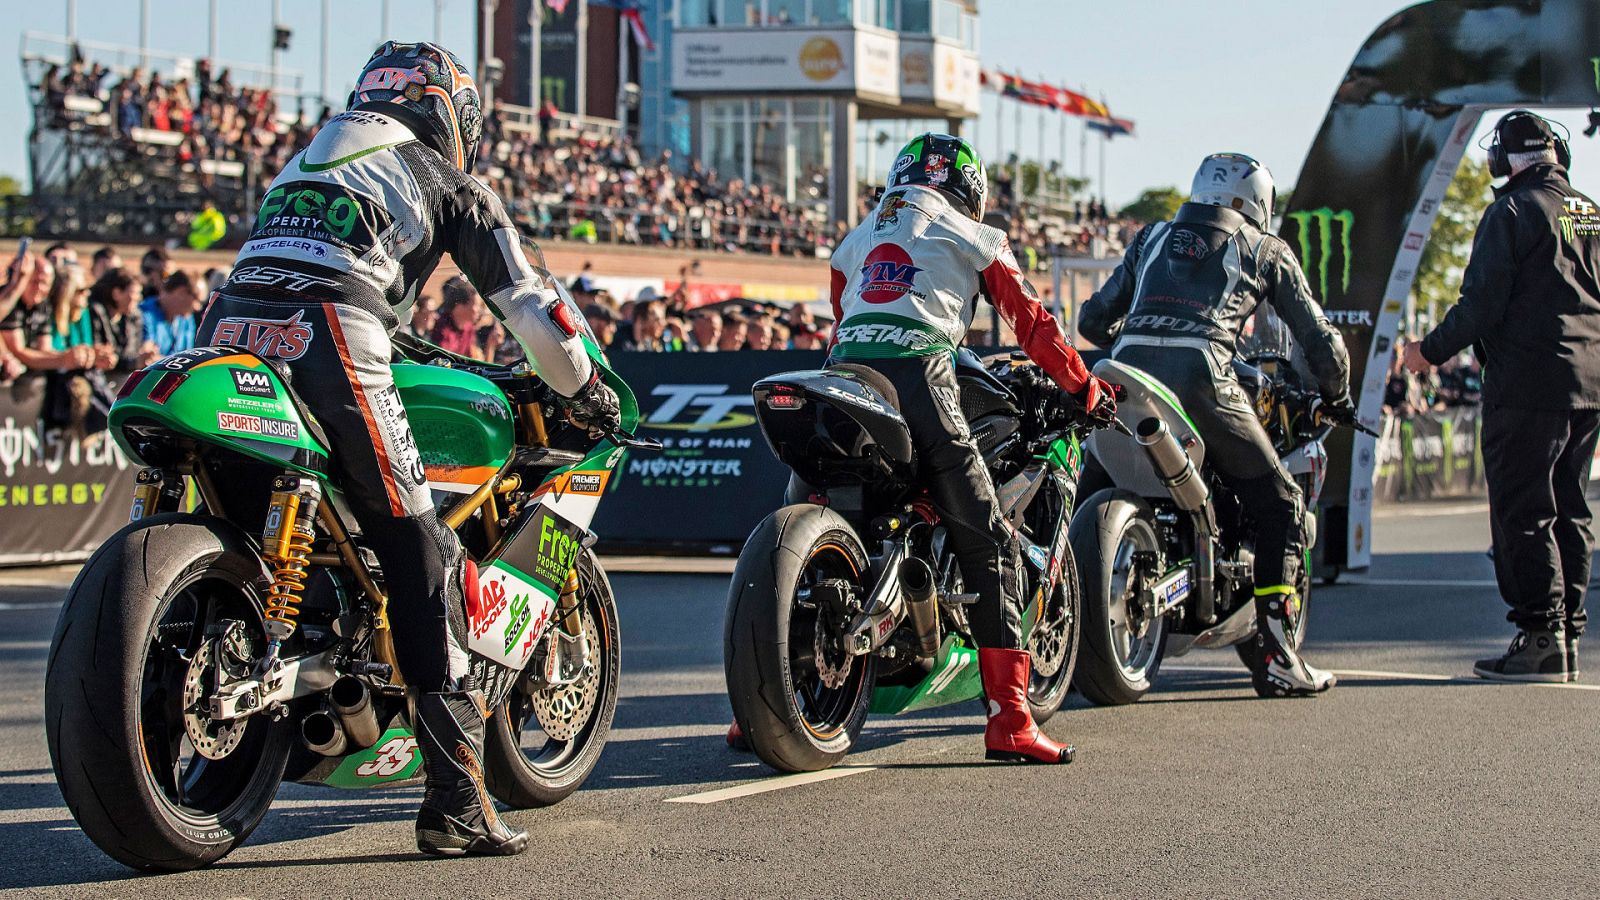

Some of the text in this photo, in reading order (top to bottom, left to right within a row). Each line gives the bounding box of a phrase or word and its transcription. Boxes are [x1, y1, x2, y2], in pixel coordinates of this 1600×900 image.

[270, 216, 323, 229] PERTY
[249, 240, 312, 252] METZELER
[210, 310, 313, 362] ELVIS
[651, 384, 754, 433] TT
[708, 438, 752, 449] MAN
[629, 457, 742, 477] MONSTER
[571, 474, 600, 484] PREMIER
[474, 596, 508, 640] TOOLS
[879, 614, 893, 635] RK
[355, 736, 418, 777] 35
